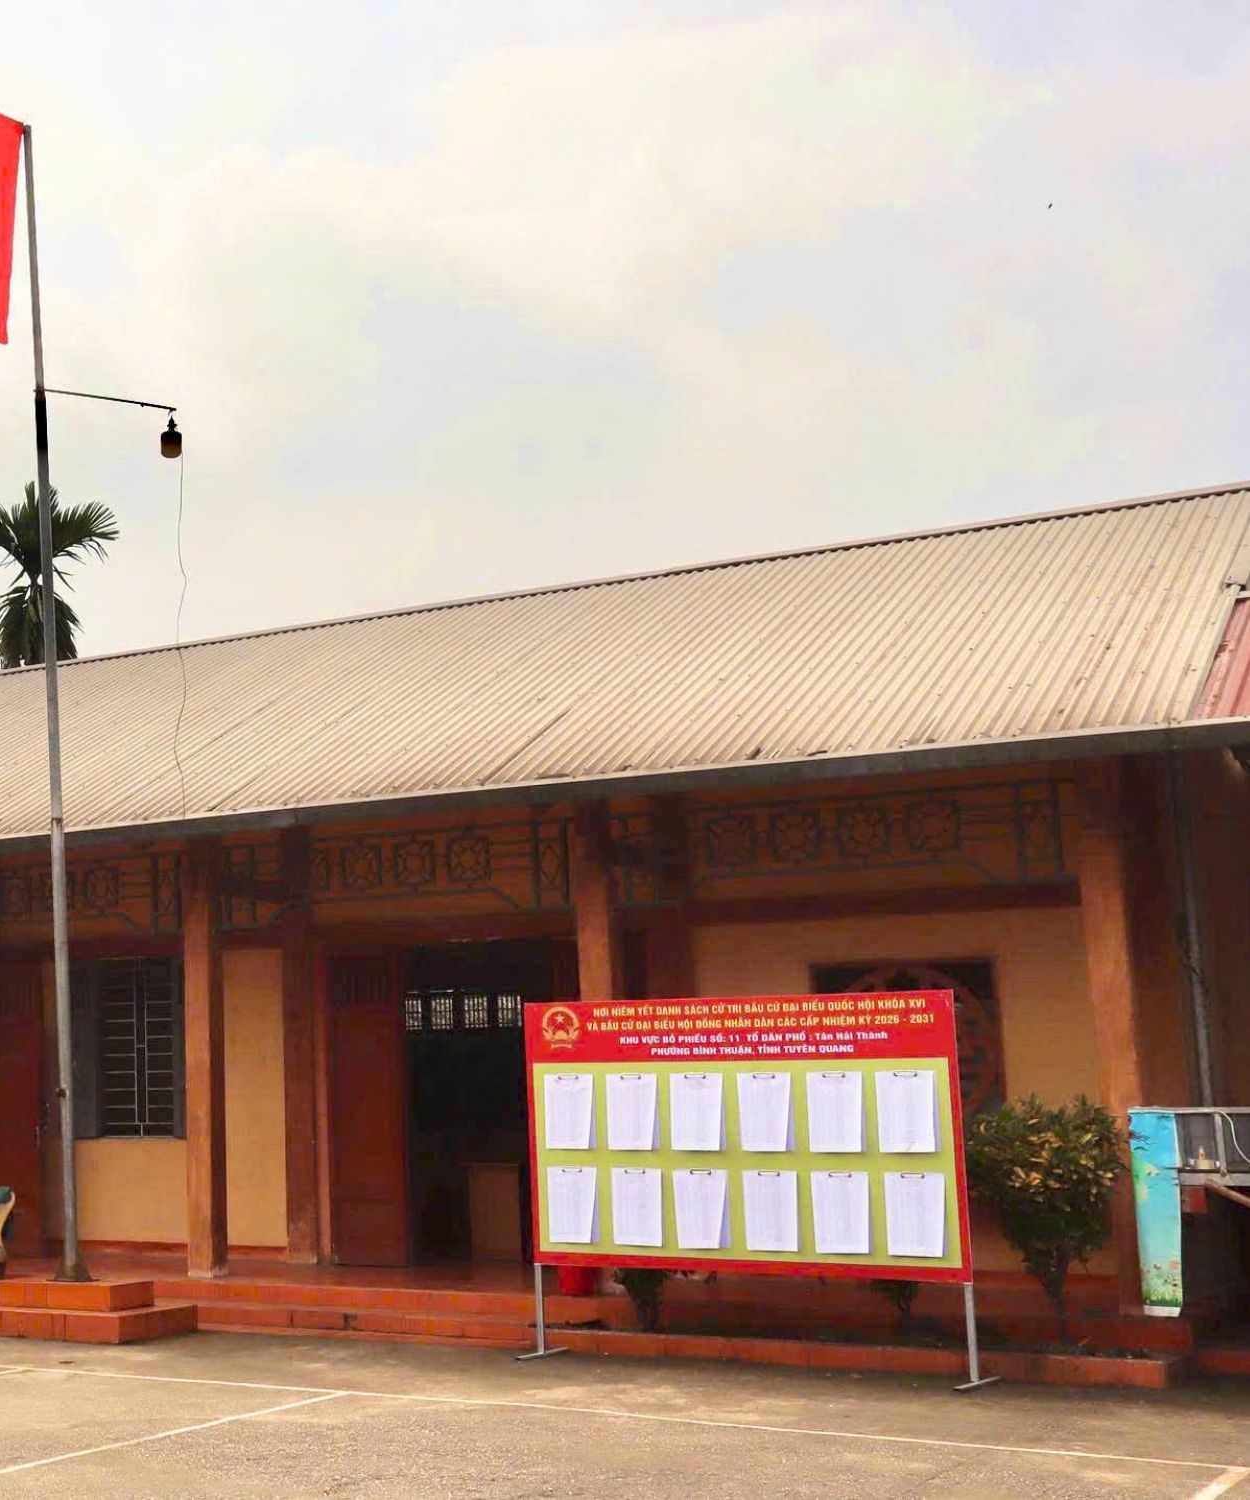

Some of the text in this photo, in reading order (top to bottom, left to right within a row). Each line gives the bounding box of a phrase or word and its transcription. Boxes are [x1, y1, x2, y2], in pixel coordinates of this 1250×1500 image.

[594, 1006, 609, 1017] NƠI
[638, 1003, 653, 1016] YẾT
[656, 1005, 681, 1016] DANH
[685, 1002, 709, 1015] SÁCH
[712, 1002, 725, 1014] CỬ
[728, 1003, 741, 1014] TRI
[744, 1002, 764, 1013] BẦU
[767, 1001, 780, 1013] CỬ
[803, 998, 825, 1011] BIỂU
[828, 998, 854, 1011] QUỐC
[858, 1000, 874, 1011] HỘI
[878, 998, 906, 1009] KHÓA
[909, 998, 926, 1009] XVI
[587, 1020, 598, 1031] VÀ
[601, 1018, 619, 1030] BẦU
[622, 1018, 635, 1030] CỬ
[654, 1016, 675, 1029] BIỂU
[678, 1018, 692, 1031] HỘI
[696, 1016, 721, 1029] ĐỒNG
[725, 1016, 750, 1028] NHÂN
[755, 1015, 774, 1027] DÂN
[778, 1015, 797, 1027] CÁC
[801, 1013, 819, 1026] CẤP
[859, 1014, 871, 1025] KỲ
[875, 1014, 900, 1024] 2026
[910, 1014, 934, 1024] 2031
[620, 1036, 638, 1045] KHU
[642, 1034, 661, 1045] VỰC
[663, 1034, 675, 1044] BỎ
[679, 1032, 707, 1044] PHIẾU
[710, 1032, 726, 1043] SỐ:
[729, 1034, 740, 1042] 11
[747, 1032, 758, 1043] TỔ
[762, 1031, 783, 1042] DÂN
[786, 1030, 806, 1041] PHỐ
[815, 1032, 833, 1041] Tân
[857, 1031, 888, 1039] Thành
[651, 1046, 690, 1055] PHƯỜNG
[693, 1045, 716, 1055] BÌNH
[758, 1044, 781, 1054] TỈNH
[784, 1044, 816, 1053] TUYÊN
[819, 1044, 854, 1053] QUANG
